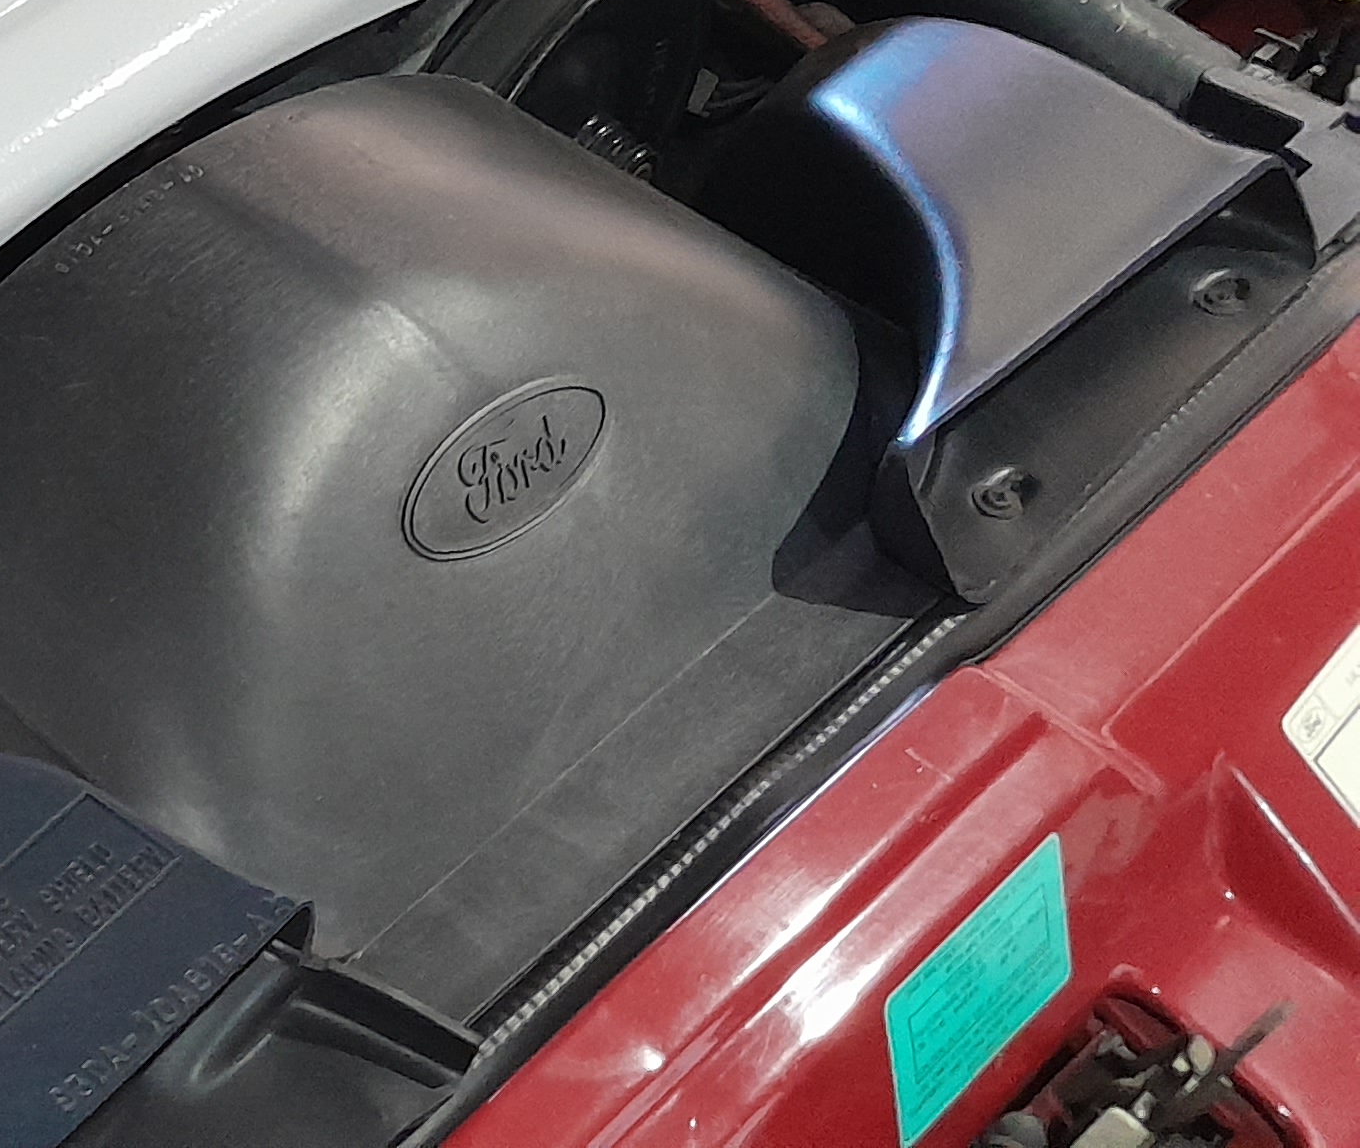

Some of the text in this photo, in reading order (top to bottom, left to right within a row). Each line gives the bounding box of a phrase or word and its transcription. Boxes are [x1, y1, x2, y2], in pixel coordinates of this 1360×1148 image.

[455, 413, 567, 525] Ford
[38, 840, 118, 915] SHIELD
[78, 842, 179, 930] BATTERY
